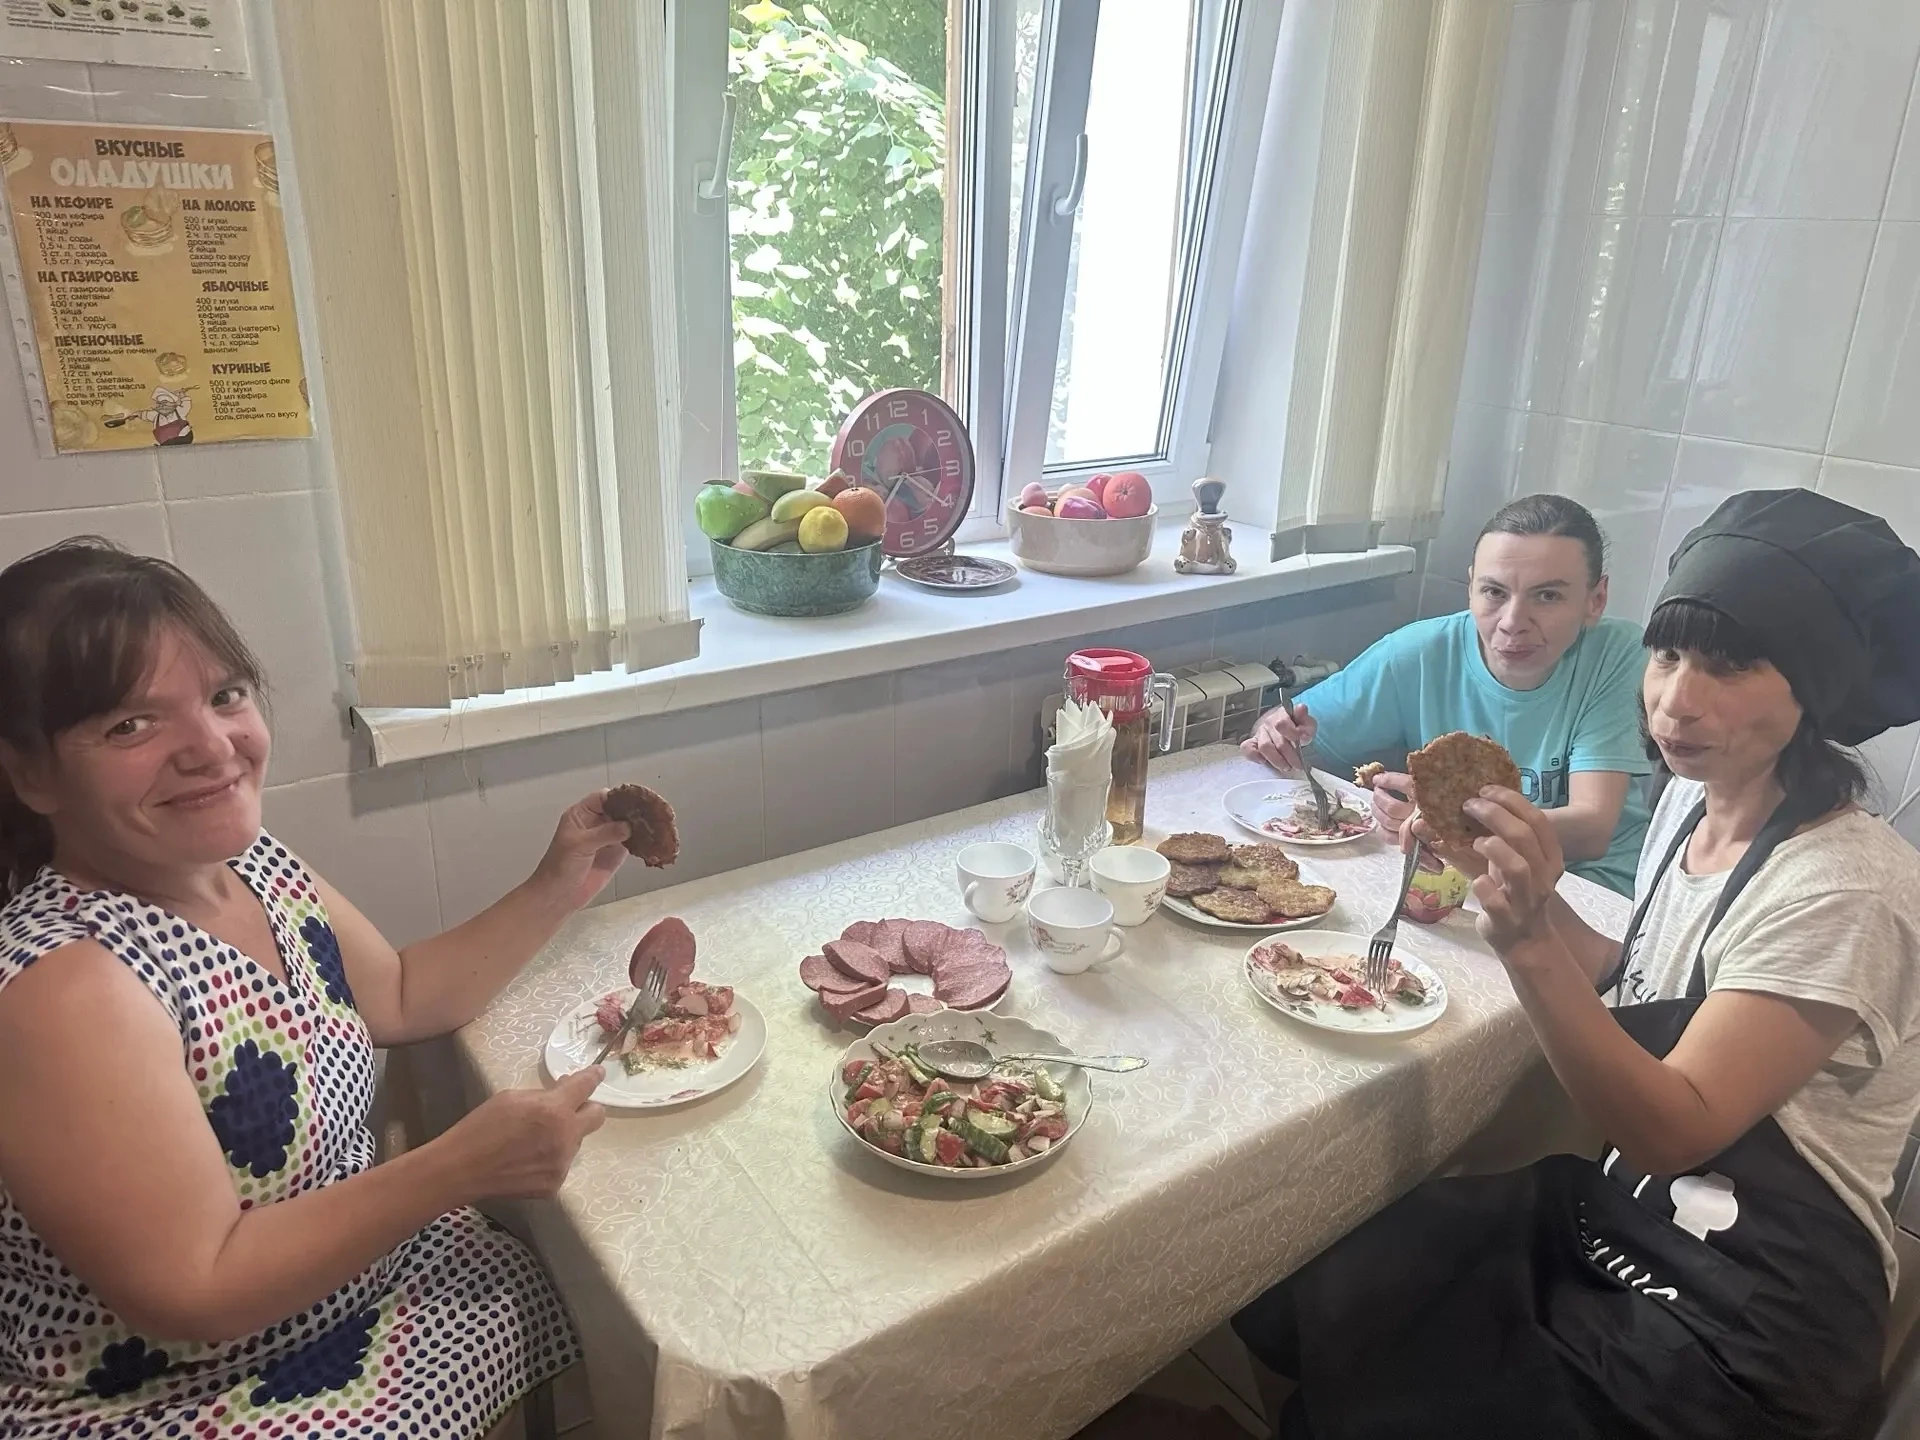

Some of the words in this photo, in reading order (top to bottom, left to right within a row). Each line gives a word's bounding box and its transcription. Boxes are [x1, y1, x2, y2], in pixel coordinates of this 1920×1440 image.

[94, 139, 185, 158] ВКУСНЫЕ
[50, 157, 234, 190] ОЛАДУШКИ
[30, 196, 52, 208] НА
[54, 196, 113, 209] КЕФИРЕ
[182, 199, 201, 210] НА
[204, 200, 256, 212] МОЛОКЕ
[37, 271, 58, 282] НА
[61, 271, 140, 282] ГАЗИРОВКЕ
[202, 280, 269, 292] ЯБЛОЧНЫЕ
[54, 334, 144, 346] ПЕЧЕНОЧНЫЕ
[212, 362, 271, 374] КУРИНЫЕ
[888, 401, 908, 418] 12
[922, 409, 928, 425] 1
[864, 413, 880, 430] 11
[937, 430, 952, 447] 2
[847, 440, 864, 457] 10
[946, 460, 960, 476] 3
[941, 494, 954, 508] 4
[924, 518, 938, 535] 5
[900, 532, 914, 547] 6
[1551, 758, 1560, 766] a
